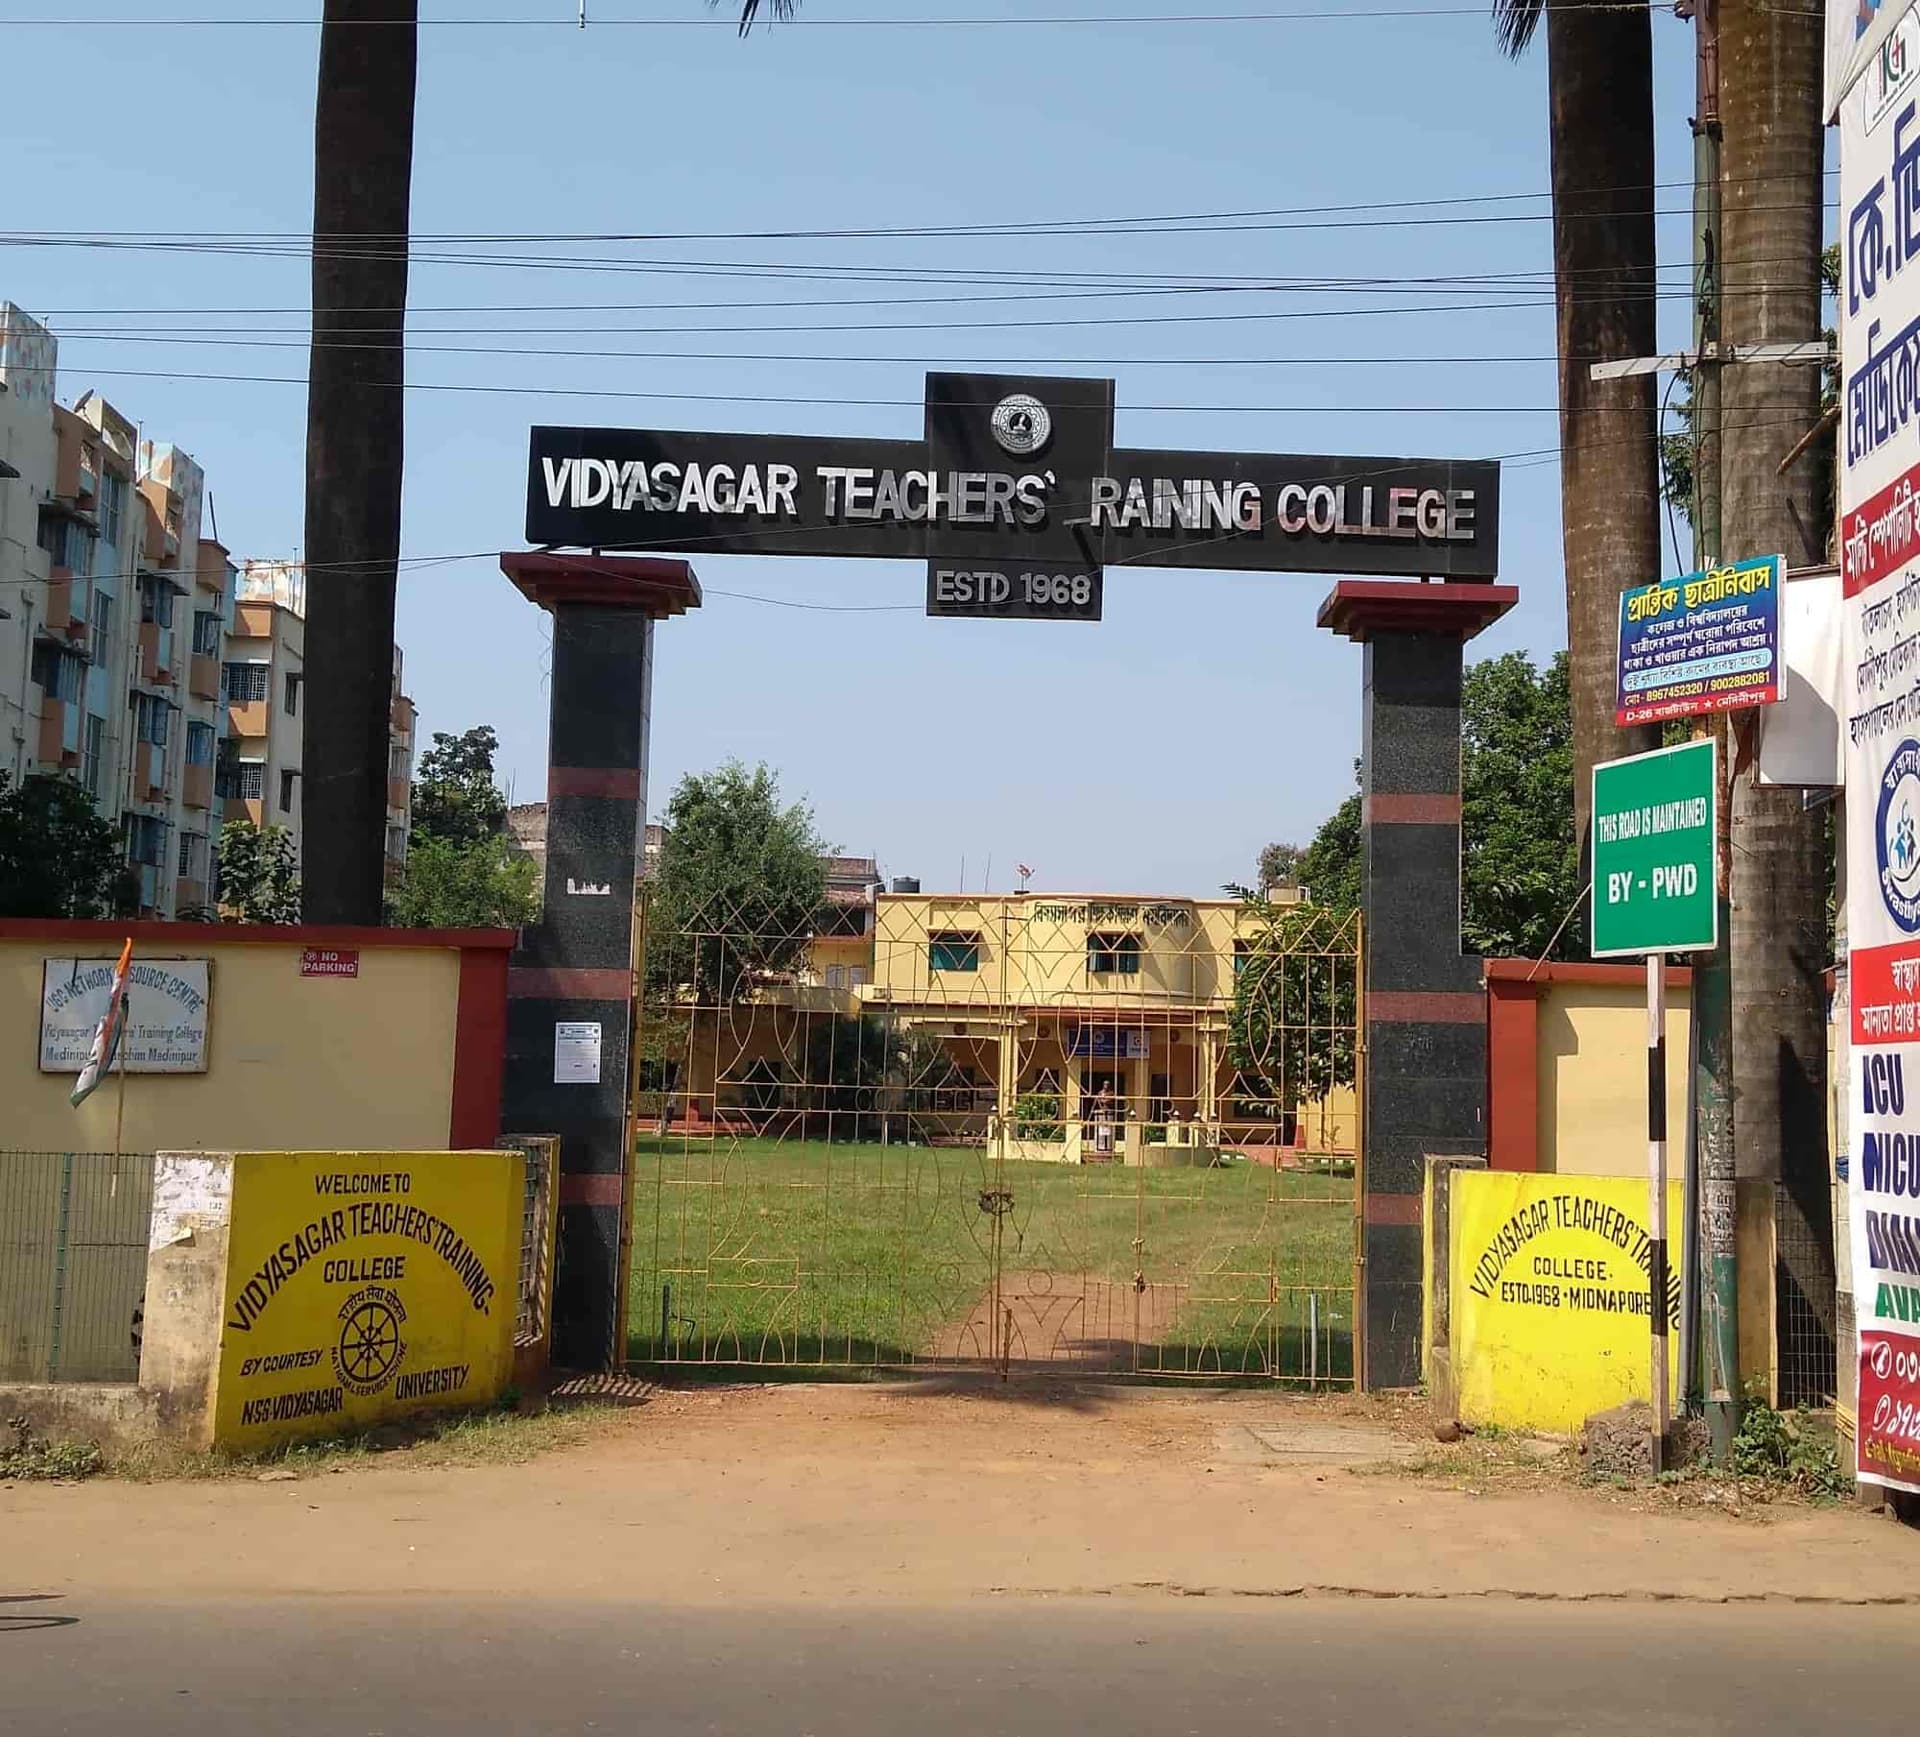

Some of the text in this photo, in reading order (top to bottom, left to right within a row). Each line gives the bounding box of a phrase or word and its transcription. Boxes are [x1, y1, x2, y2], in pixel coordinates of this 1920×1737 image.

[542, 457, 798, 515] VIDYASAGAR
[1278, 484, 1475, 539] COLLEGE
[936, 570, 1091, 605] ESTD 1968
[1599, 797, 1707, 843] THIS ROAD IS MAINTAINED
[1608, 871, 1633, 904] BY
[1652, 863, 1698, 899] PWD
[304, 962, 355, 973] PARKING
[322, 951, 338, 961] NO
[1863, 1053, 1904, 1116] ICU
[315, 1173, 410, 1194] WELCOME TO
[1862, 1132, 1920, 1199] NICU
[1470, 1200, 1550, 1299] VIDYASAGAR
[228, 1210, 346, 1331] VIDYASAGAR
[323, 1256, 406, 1283] COLLEGE
[240, 1349, 323, 1376] BY COURTESY
[396, 1365, 469, 1399] UNIVERSITY
